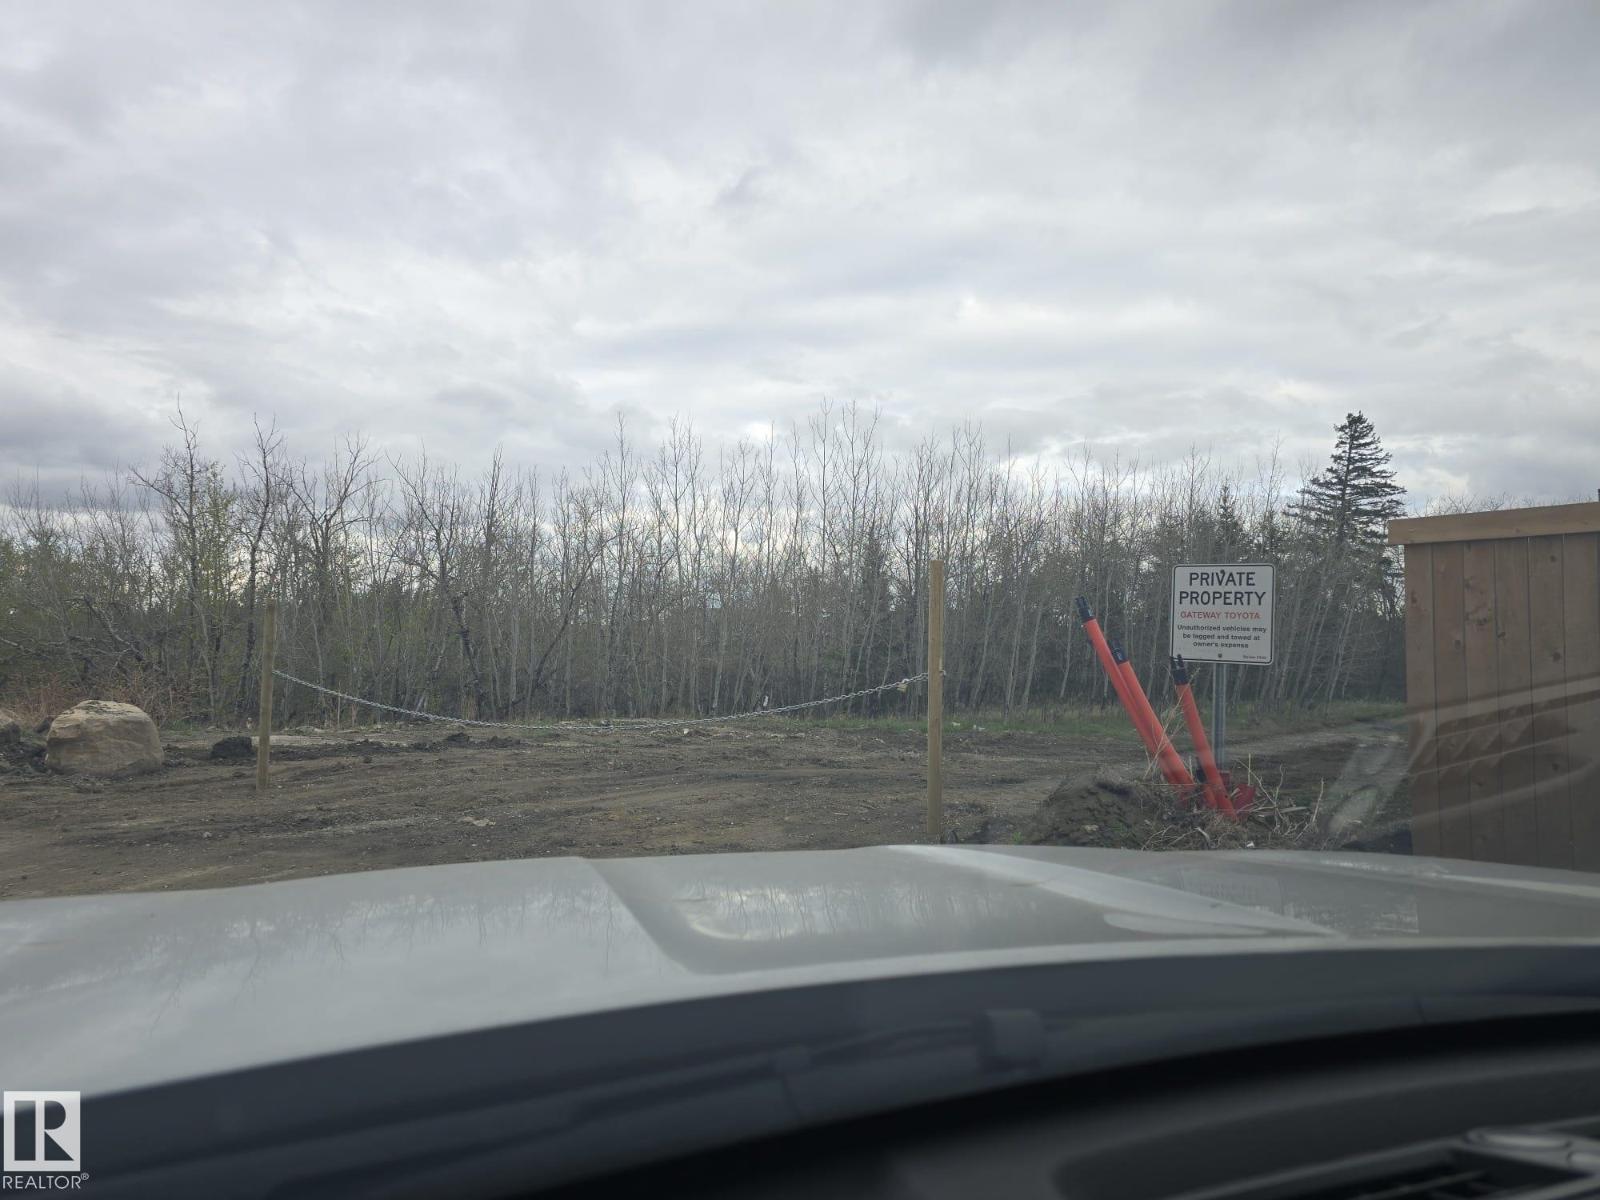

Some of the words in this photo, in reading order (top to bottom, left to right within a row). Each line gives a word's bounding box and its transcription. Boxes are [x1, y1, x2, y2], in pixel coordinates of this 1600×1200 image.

[1189, 572, 1256, 586] PRIVATE
[1179, 591, 1266, 605] PROPERTY
[1180, 611, 1221, 620] GATEWAY
[1225, 611, 1261, 620] TOYOTA
